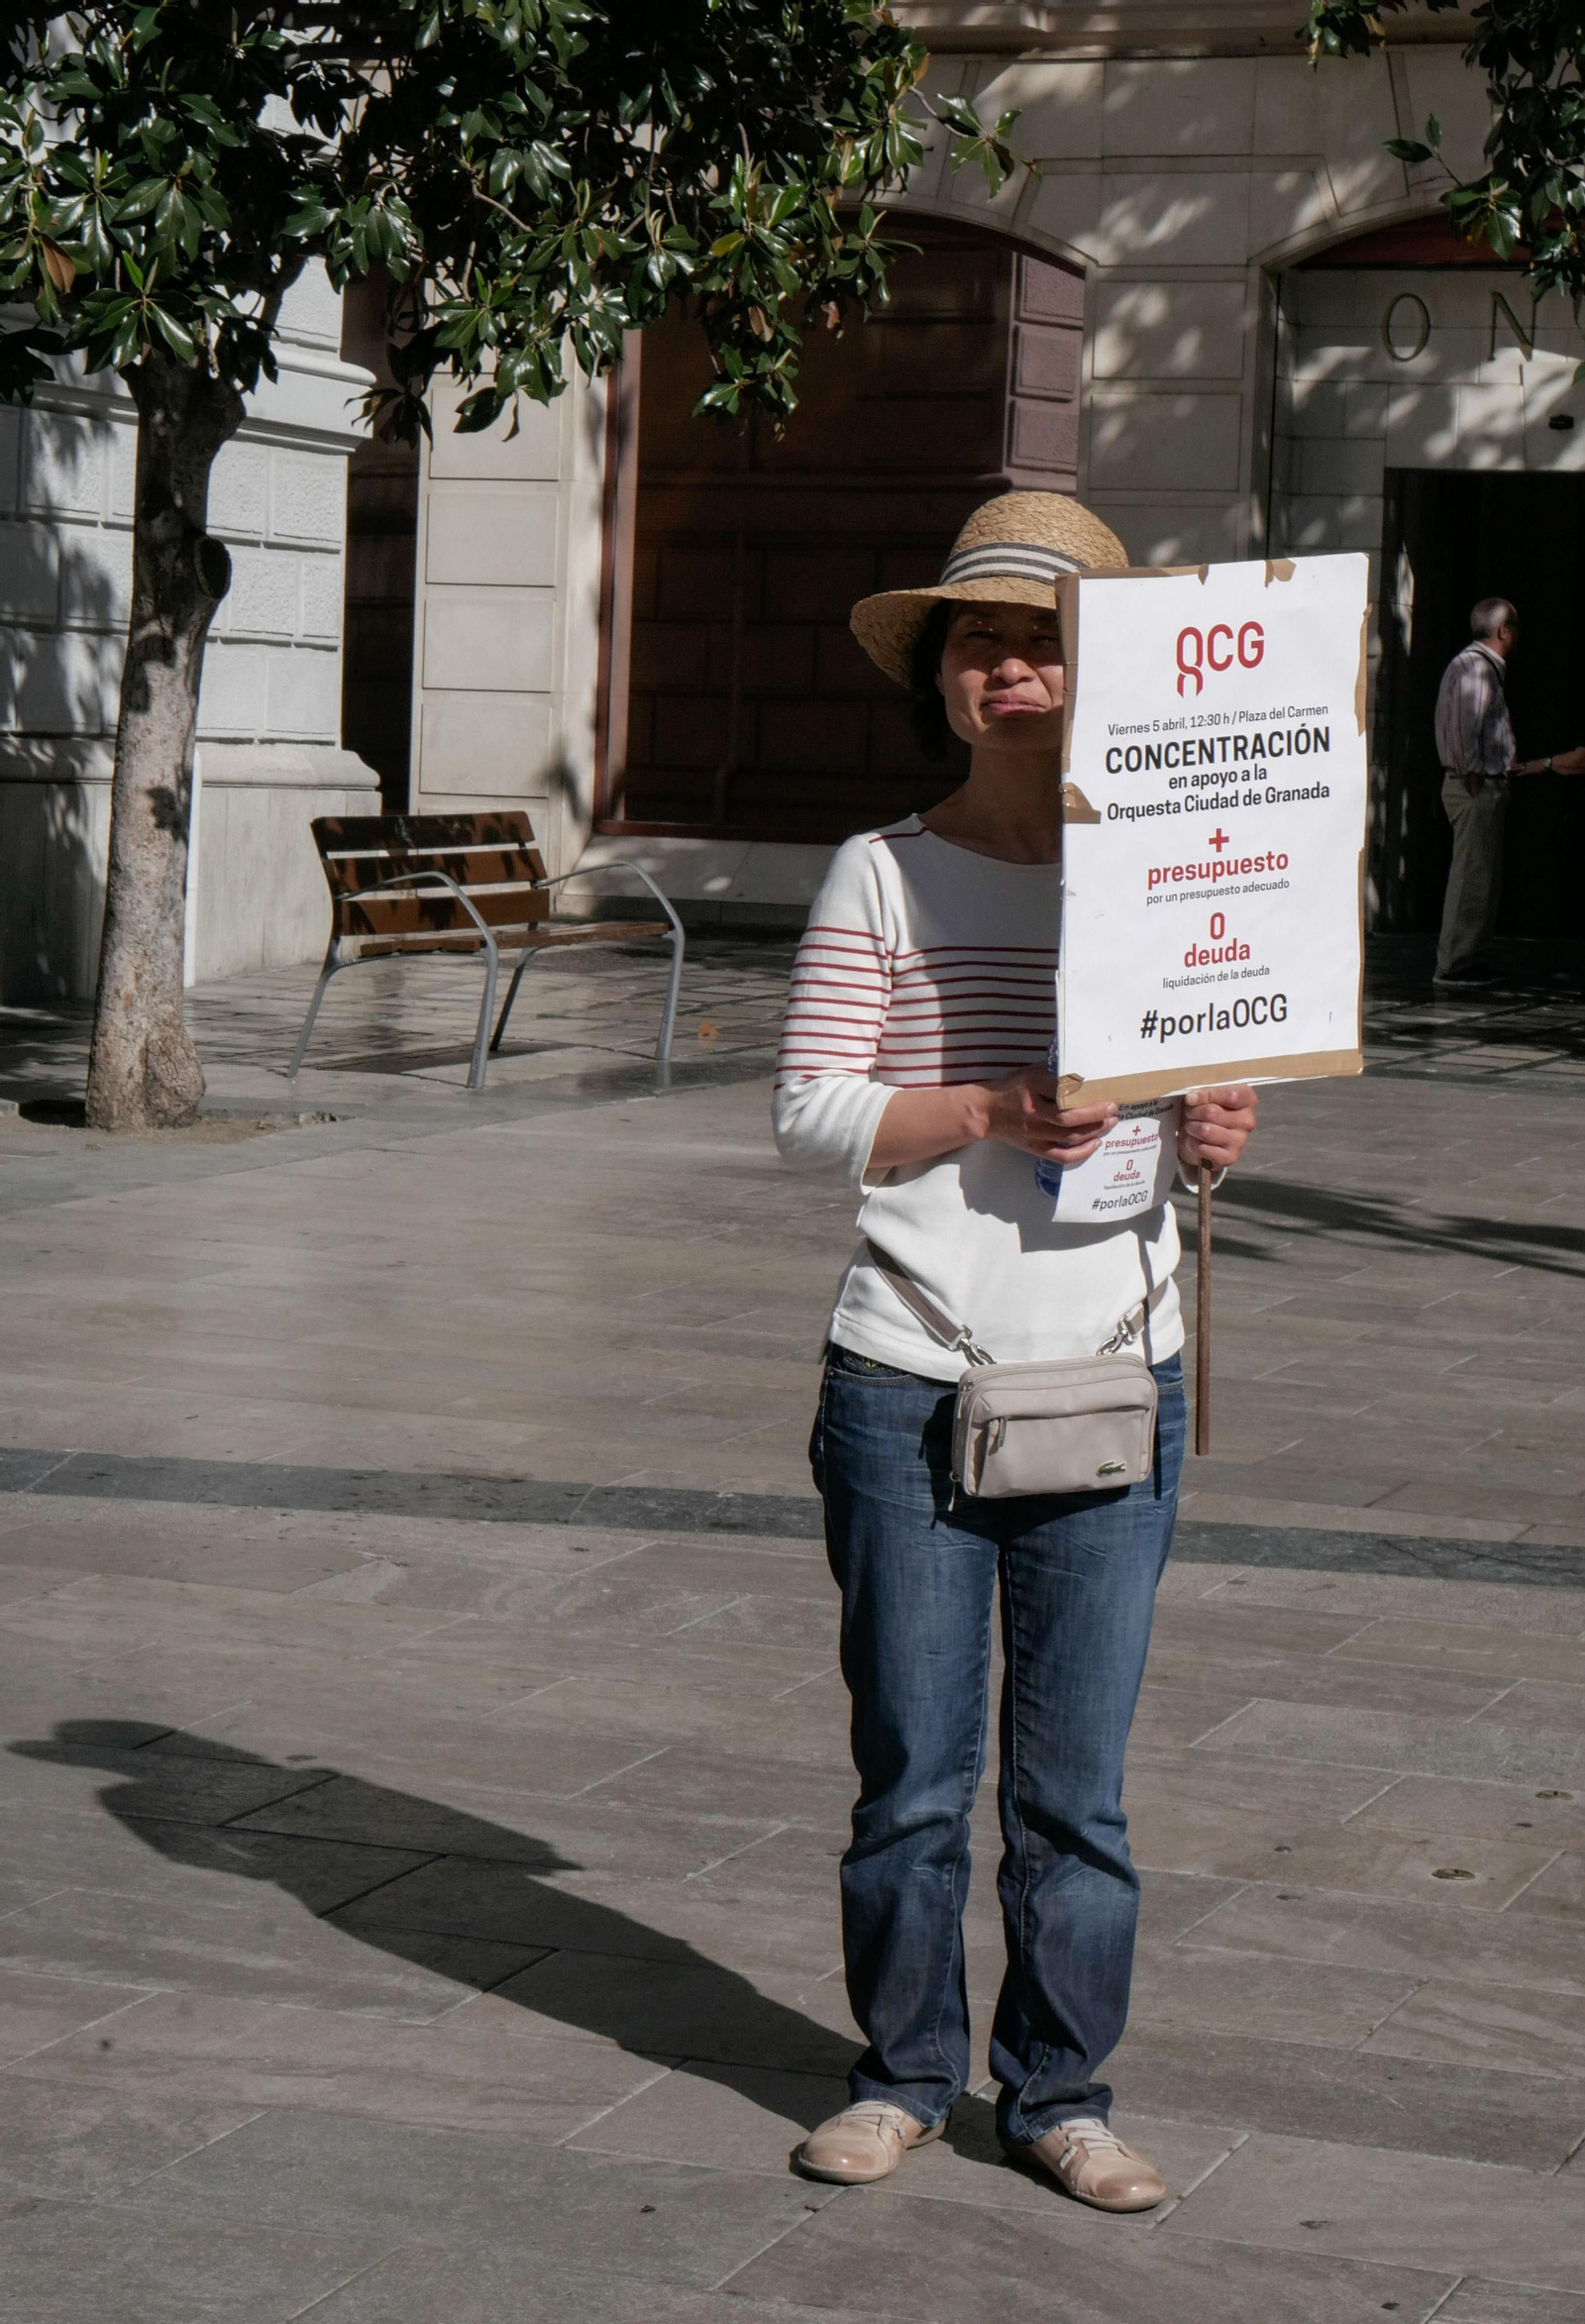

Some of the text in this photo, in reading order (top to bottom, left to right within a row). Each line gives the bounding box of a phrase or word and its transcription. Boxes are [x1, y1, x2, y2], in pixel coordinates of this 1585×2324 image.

[1109, 705, 1328, 737] Viernes 5 abril, 12:30 h / Plaza del Carmen
[1106, 723, 1330, 774] CONCENTRACIÓN
[1169, 763, 1268, 791] en apoyo a la
[1108, 782, 1330, 822] Orquesta Ciudad de Granada
[1147, 851, 1290, 891] presupuesto
[1146, 878, 1290, 906] por un presupuesto adecuado
[1210, 911, 1225, 940] 0
[1184, 938, 1251, 968] deuda
[1162, 965, 1271, 990] liquidación de la deuda
[1140, 993, 1288, 1043] #porlaOCG
[1105, 1133, 1159, 1150] presupuesto
[1113, 1169, 1141, 1182] deuda
[1092, 1190, 1148, 1212] #porlaOCG
